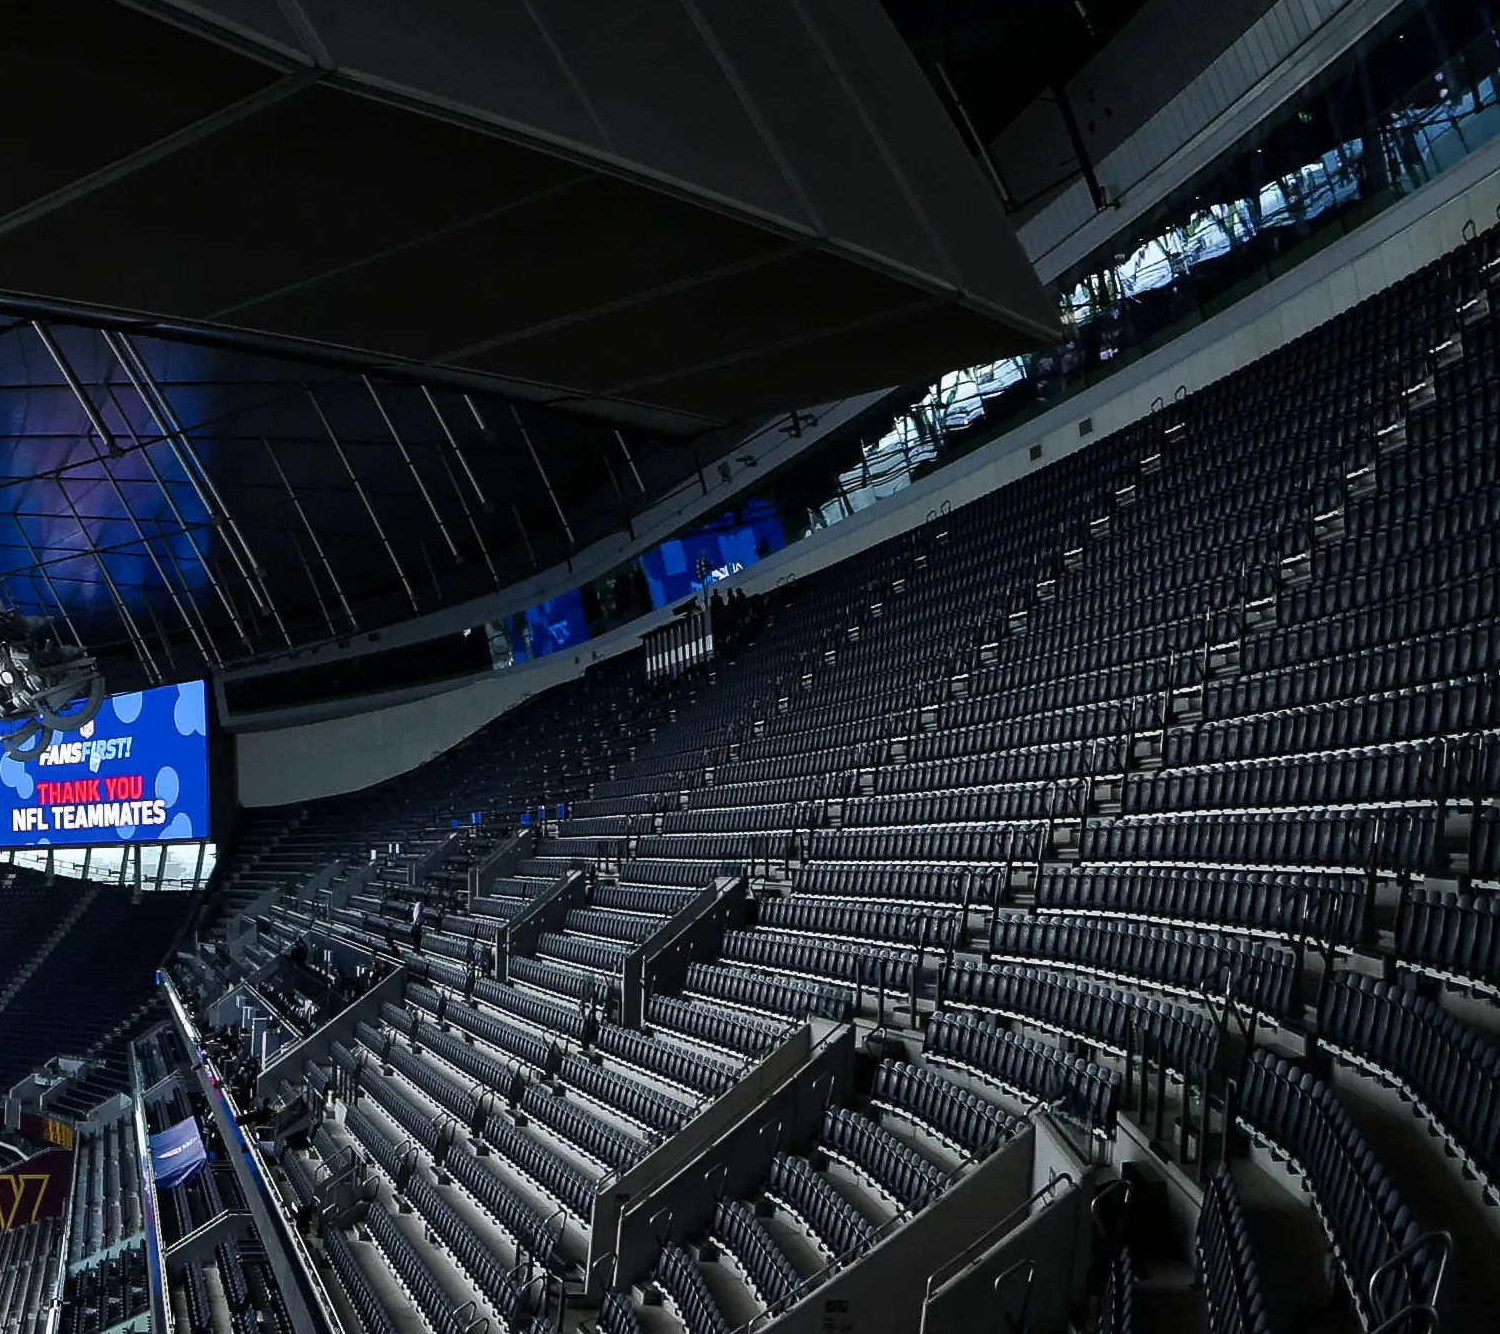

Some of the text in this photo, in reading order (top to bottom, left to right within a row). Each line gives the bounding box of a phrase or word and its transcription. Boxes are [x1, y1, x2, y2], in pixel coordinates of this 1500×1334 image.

[37, 775, 143, 805] THANK YOU
[12, 800, 166, 832] NFL TEAMMATES
